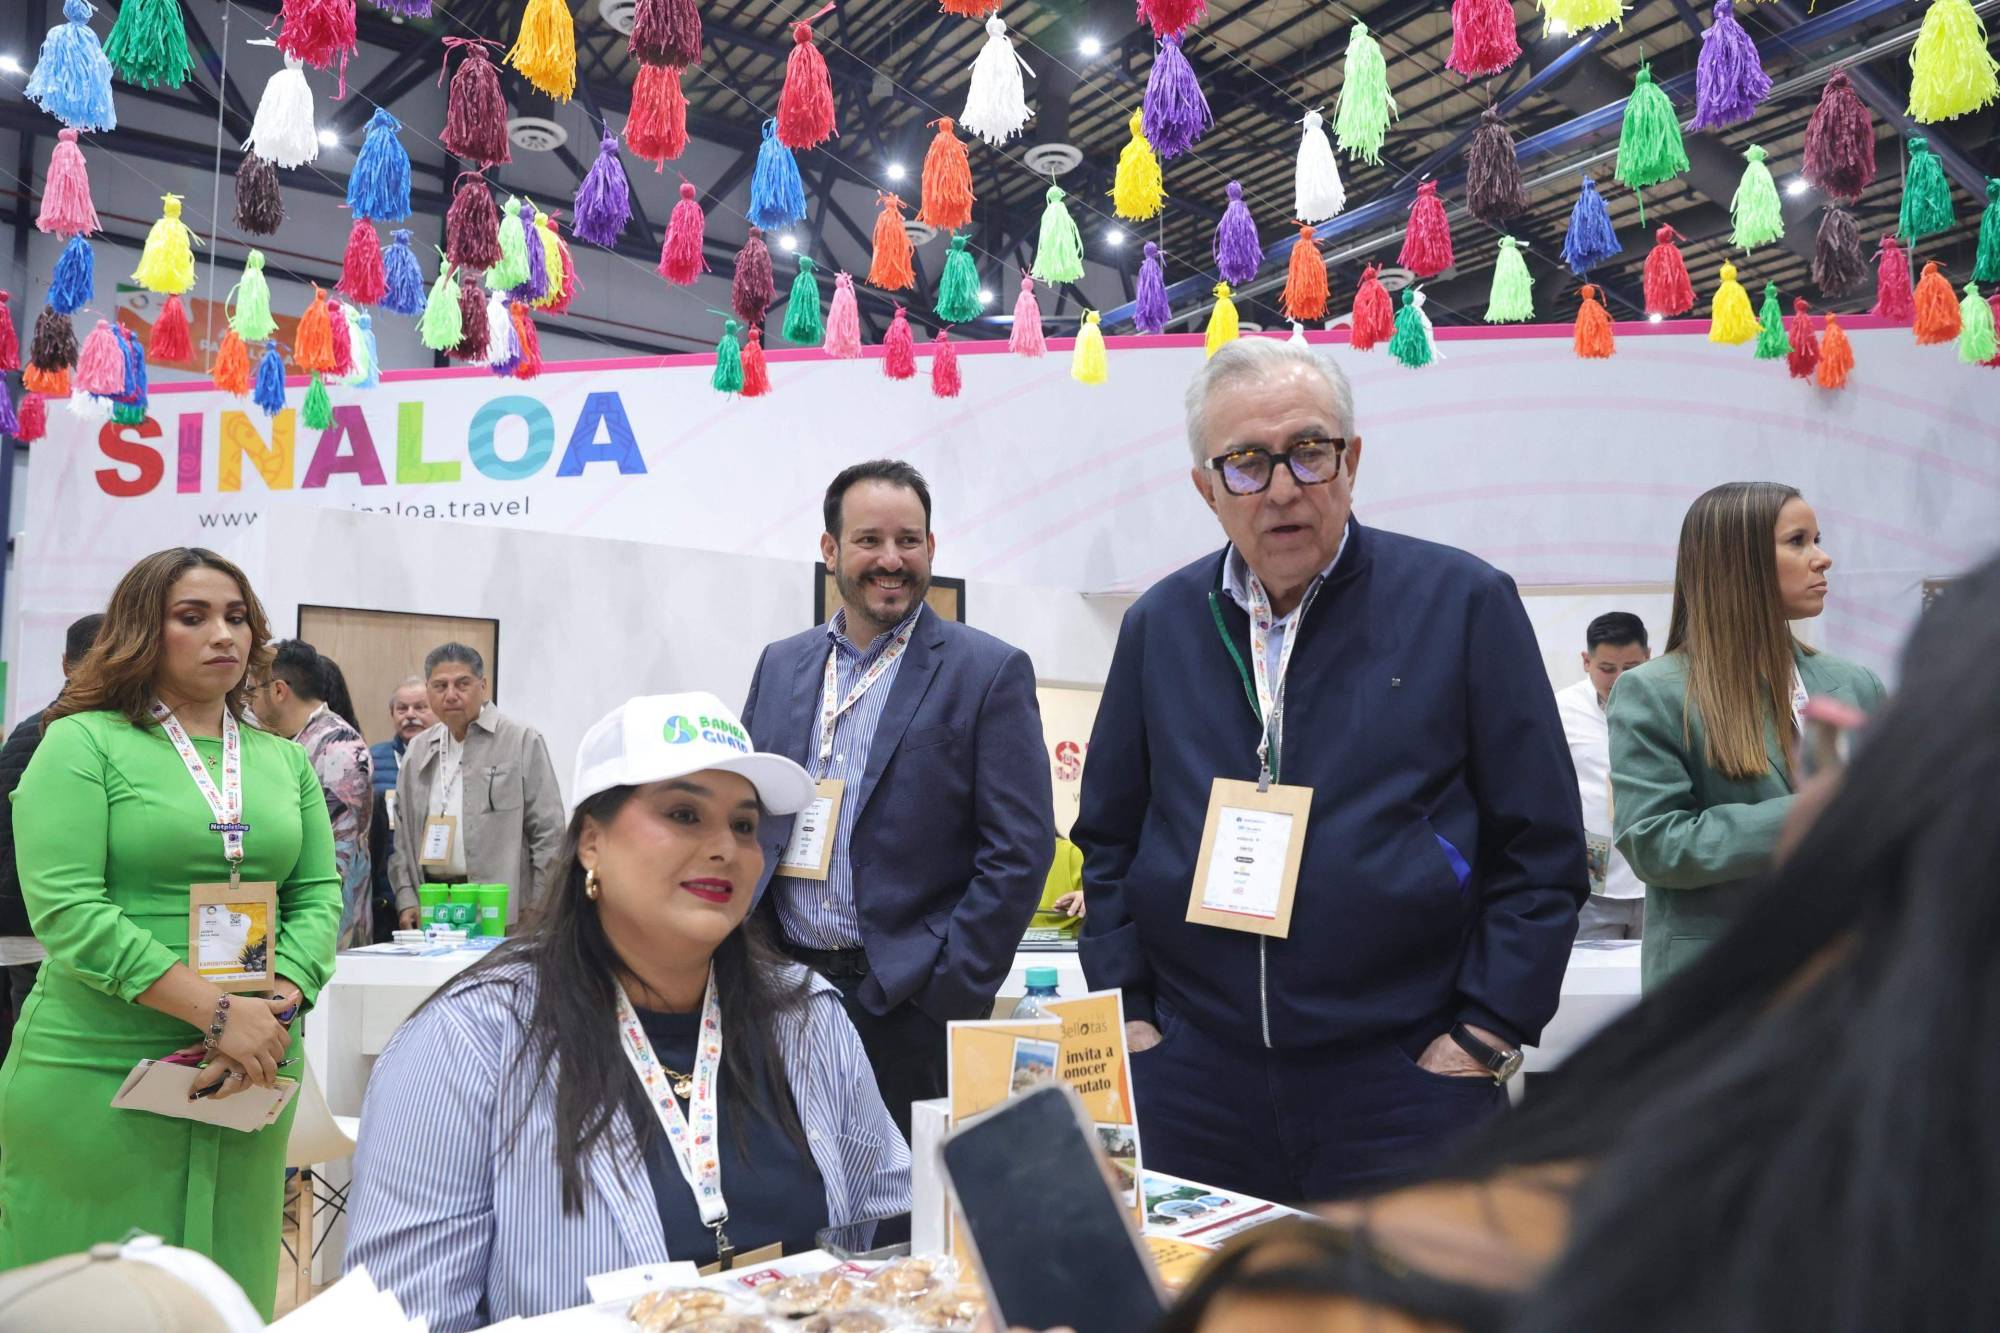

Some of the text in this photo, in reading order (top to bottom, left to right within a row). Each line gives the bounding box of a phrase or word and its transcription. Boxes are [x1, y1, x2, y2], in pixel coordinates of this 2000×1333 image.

[95, 391, 648, 498] SINALOA
[1066, 1047, 1114, 1064] invita a
[1064, 1062, 1107, 1079] onocer
